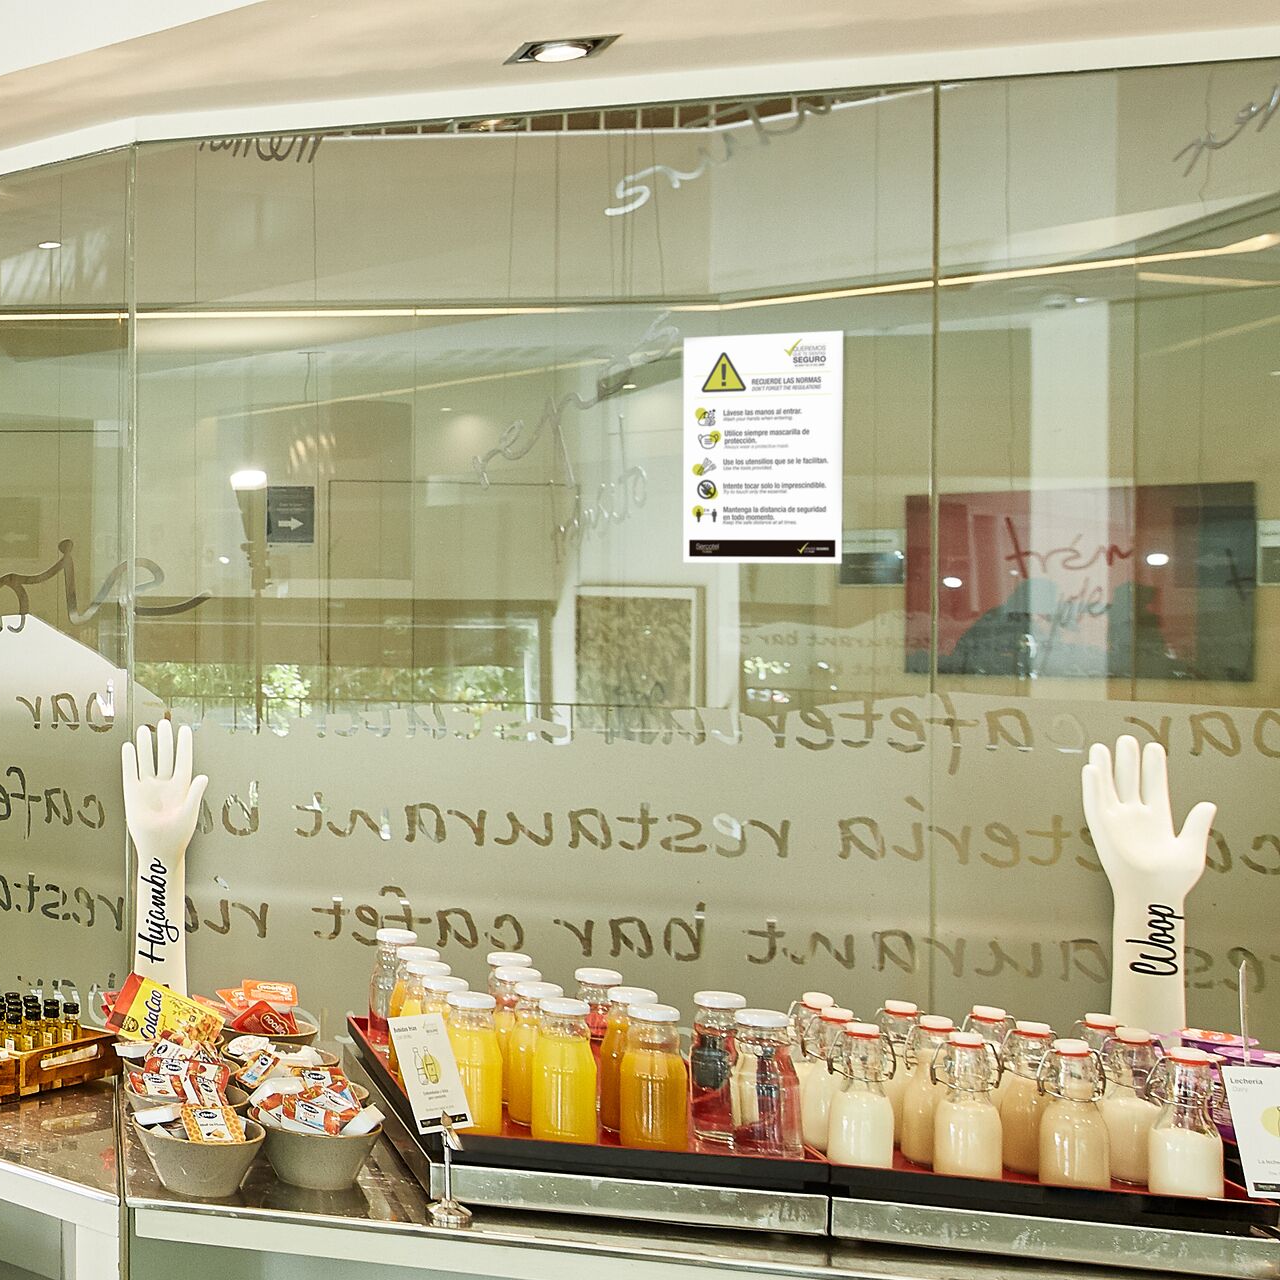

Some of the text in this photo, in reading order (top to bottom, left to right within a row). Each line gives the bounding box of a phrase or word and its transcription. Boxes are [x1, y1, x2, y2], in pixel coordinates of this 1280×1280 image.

[793, 356, 827, 364] SEGURO
[796, 376, 822, 384] NORMAS
[138, 857, 180, 964] Hujambo
[140, 989, 163, 1040] ColaCao
